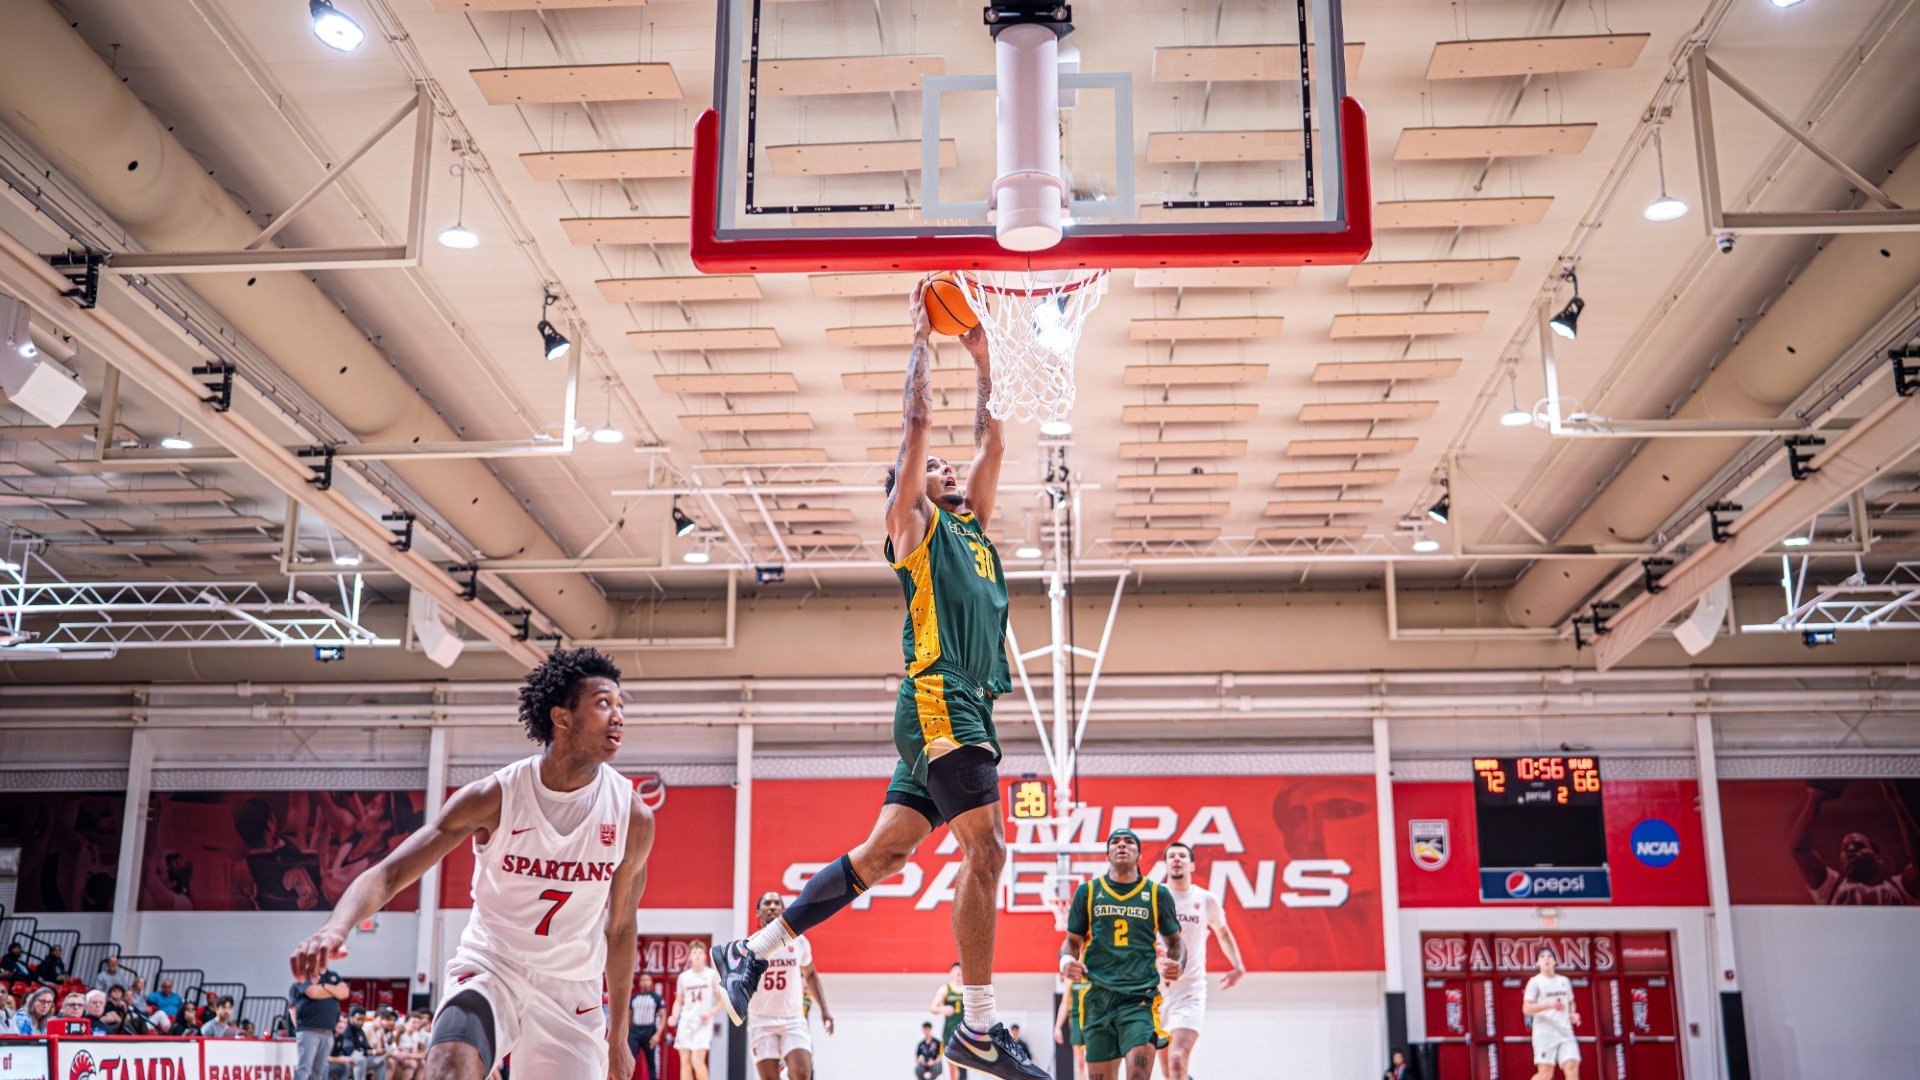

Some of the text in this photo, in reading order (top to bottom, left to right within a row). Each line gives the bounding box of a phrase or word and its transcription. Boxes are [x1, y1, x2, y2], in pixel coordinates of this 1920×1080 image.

[968, 541, 996, 583] 30
[1516, 757, 1566, 780] 10:56
[1480, 771, 1506, 793] 72
[1573, 770, 1601, 792] 66
[1014, 791, 1047, 818] 28
[1525, 790, 1552, 802] period
[1557, 786, 1569, 804] 2
[912, 806, 1245, 854] MPA
[1637, 841, 1679, 856] NCAA
[502, 854, 615, 882] SPARTANS
[1534, 874, 1585, 896] pepsi
[534, 889, 573, 936] 7
[1094, 905, 1149, 919] SAINT LEO
[1114, 919, 1129, 947] 2
[1424, 936, 1614, 973] SPARTANS
[764, 970, 787, 991] 55
[691, 991, 704, 1003] 14
[3, 1053, 13, 1070] of
[208, 1065, 295, 1080] BASKETBA
